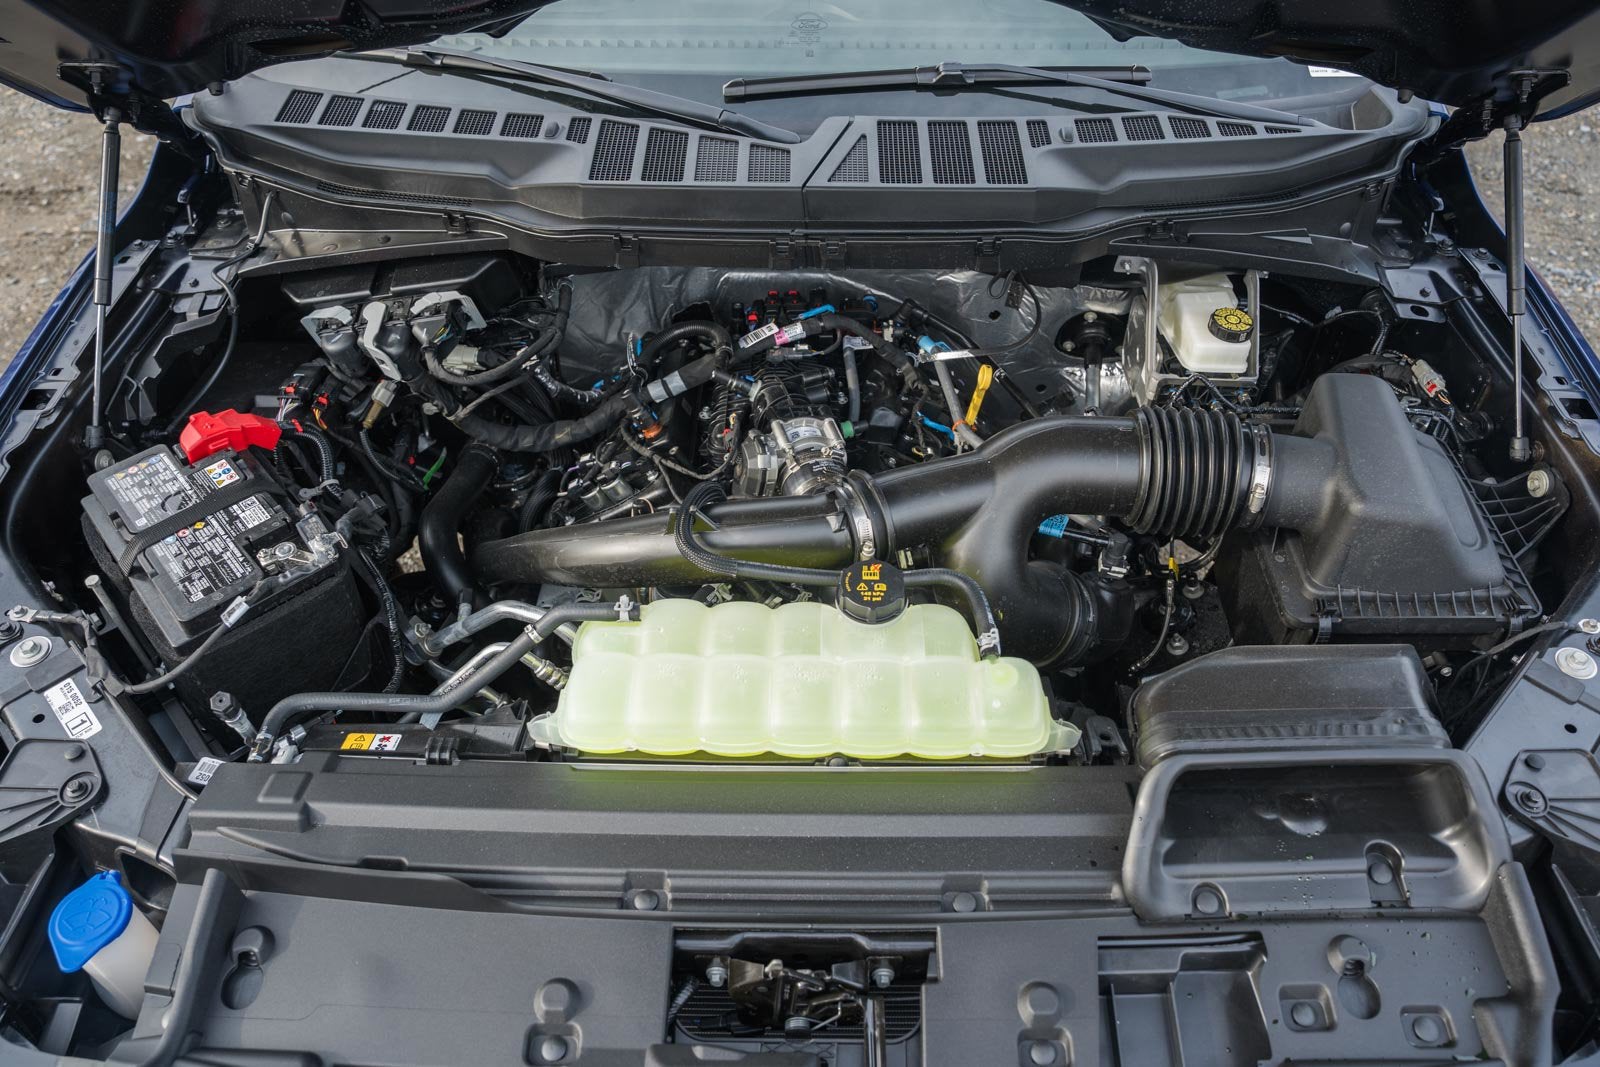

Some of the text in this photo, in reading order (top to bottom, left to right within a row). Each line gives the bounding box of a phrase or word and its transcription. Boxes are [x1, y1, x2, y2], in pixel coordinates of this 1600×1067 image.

[798, 20, 821, 30] Ford
[63, 682, 75, 694] 015
[69, 692, 83, 707] 0052
[71, 718, 88, 731] 1
